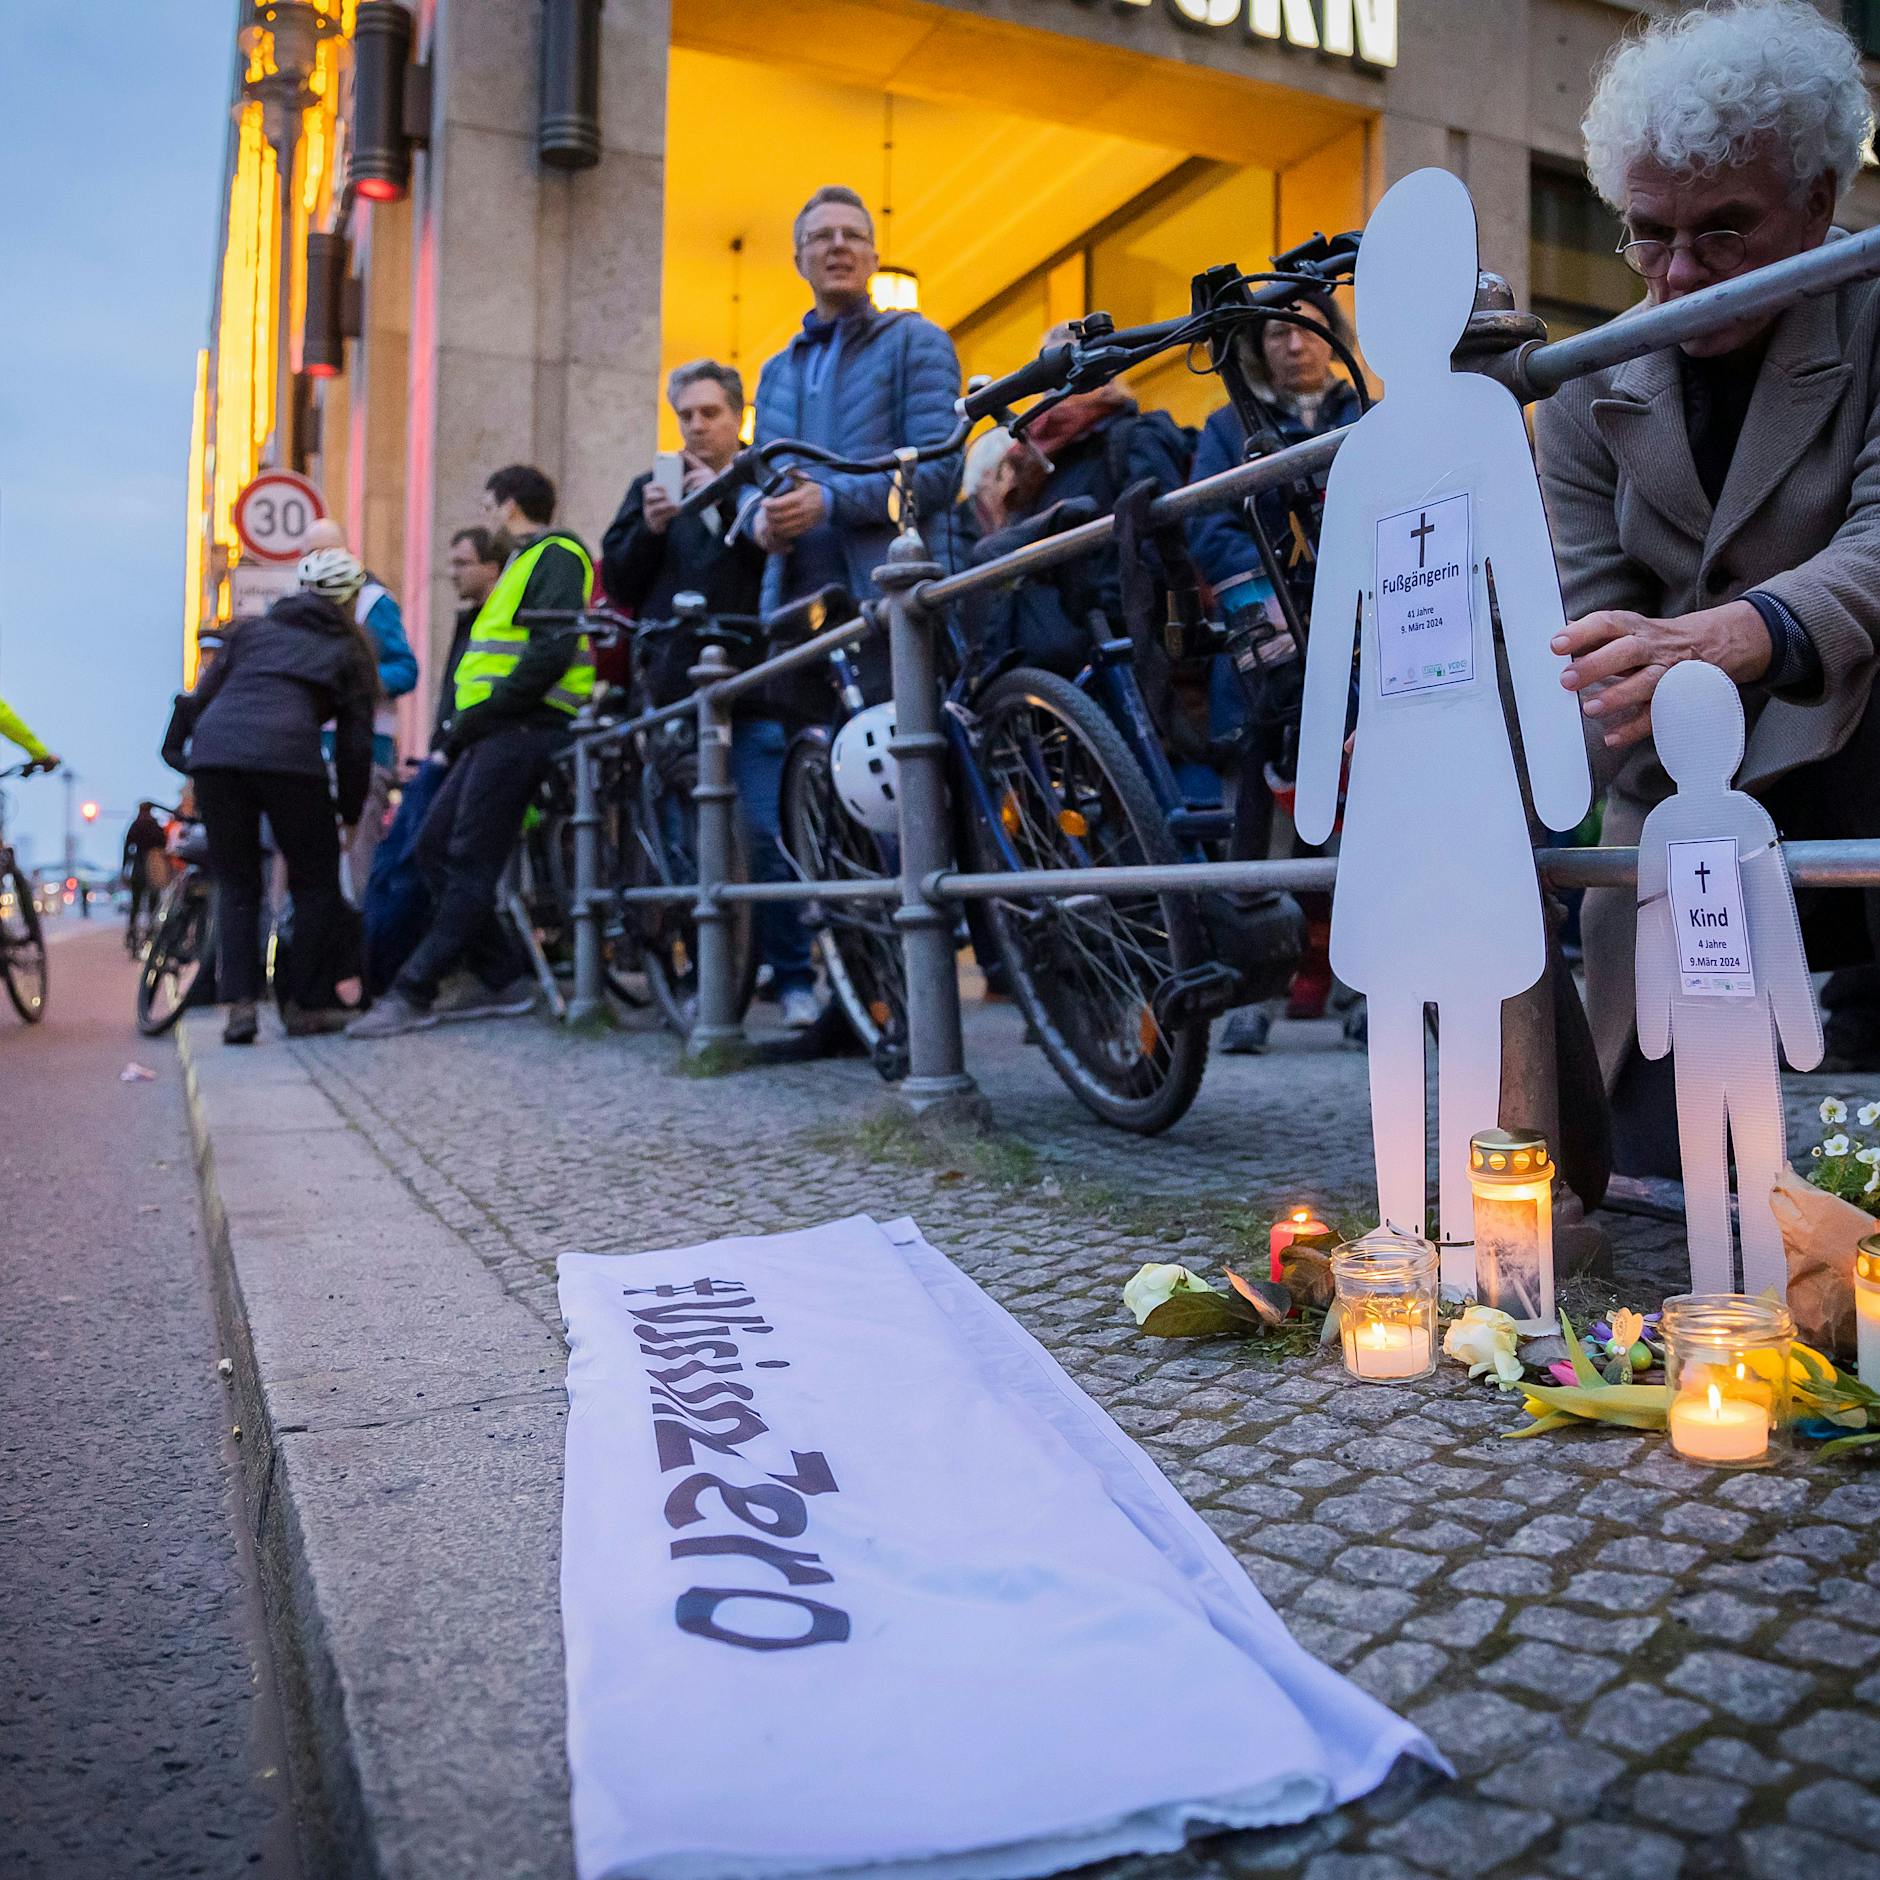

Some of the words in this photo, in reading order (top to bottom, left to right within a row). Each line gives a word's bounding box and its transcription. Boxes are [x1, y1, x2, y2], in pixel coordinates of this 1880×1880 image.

[254, 498, 306, 537] 30
[1382, 561, 1459, 595] Fußgängerin
[1407, 610, 1415, 619] 41
[1416, 606, 1434, 617] Jahre
[1400, 625, 1407, 634] 9.
[1408, 622, 1425, 633] März
[1426, 617, 1443, 629] 2024
[1689, 906, 1729, 928] Kind
[1698, 939, 1704, 949] 4
[1705, 939, 1727, 949] Jahre
[1689, 957, 1718, 967] 9.März
[1719, 957, 1740, 967] 2024
[623, 1276, 851, 1652] #VisionZero
